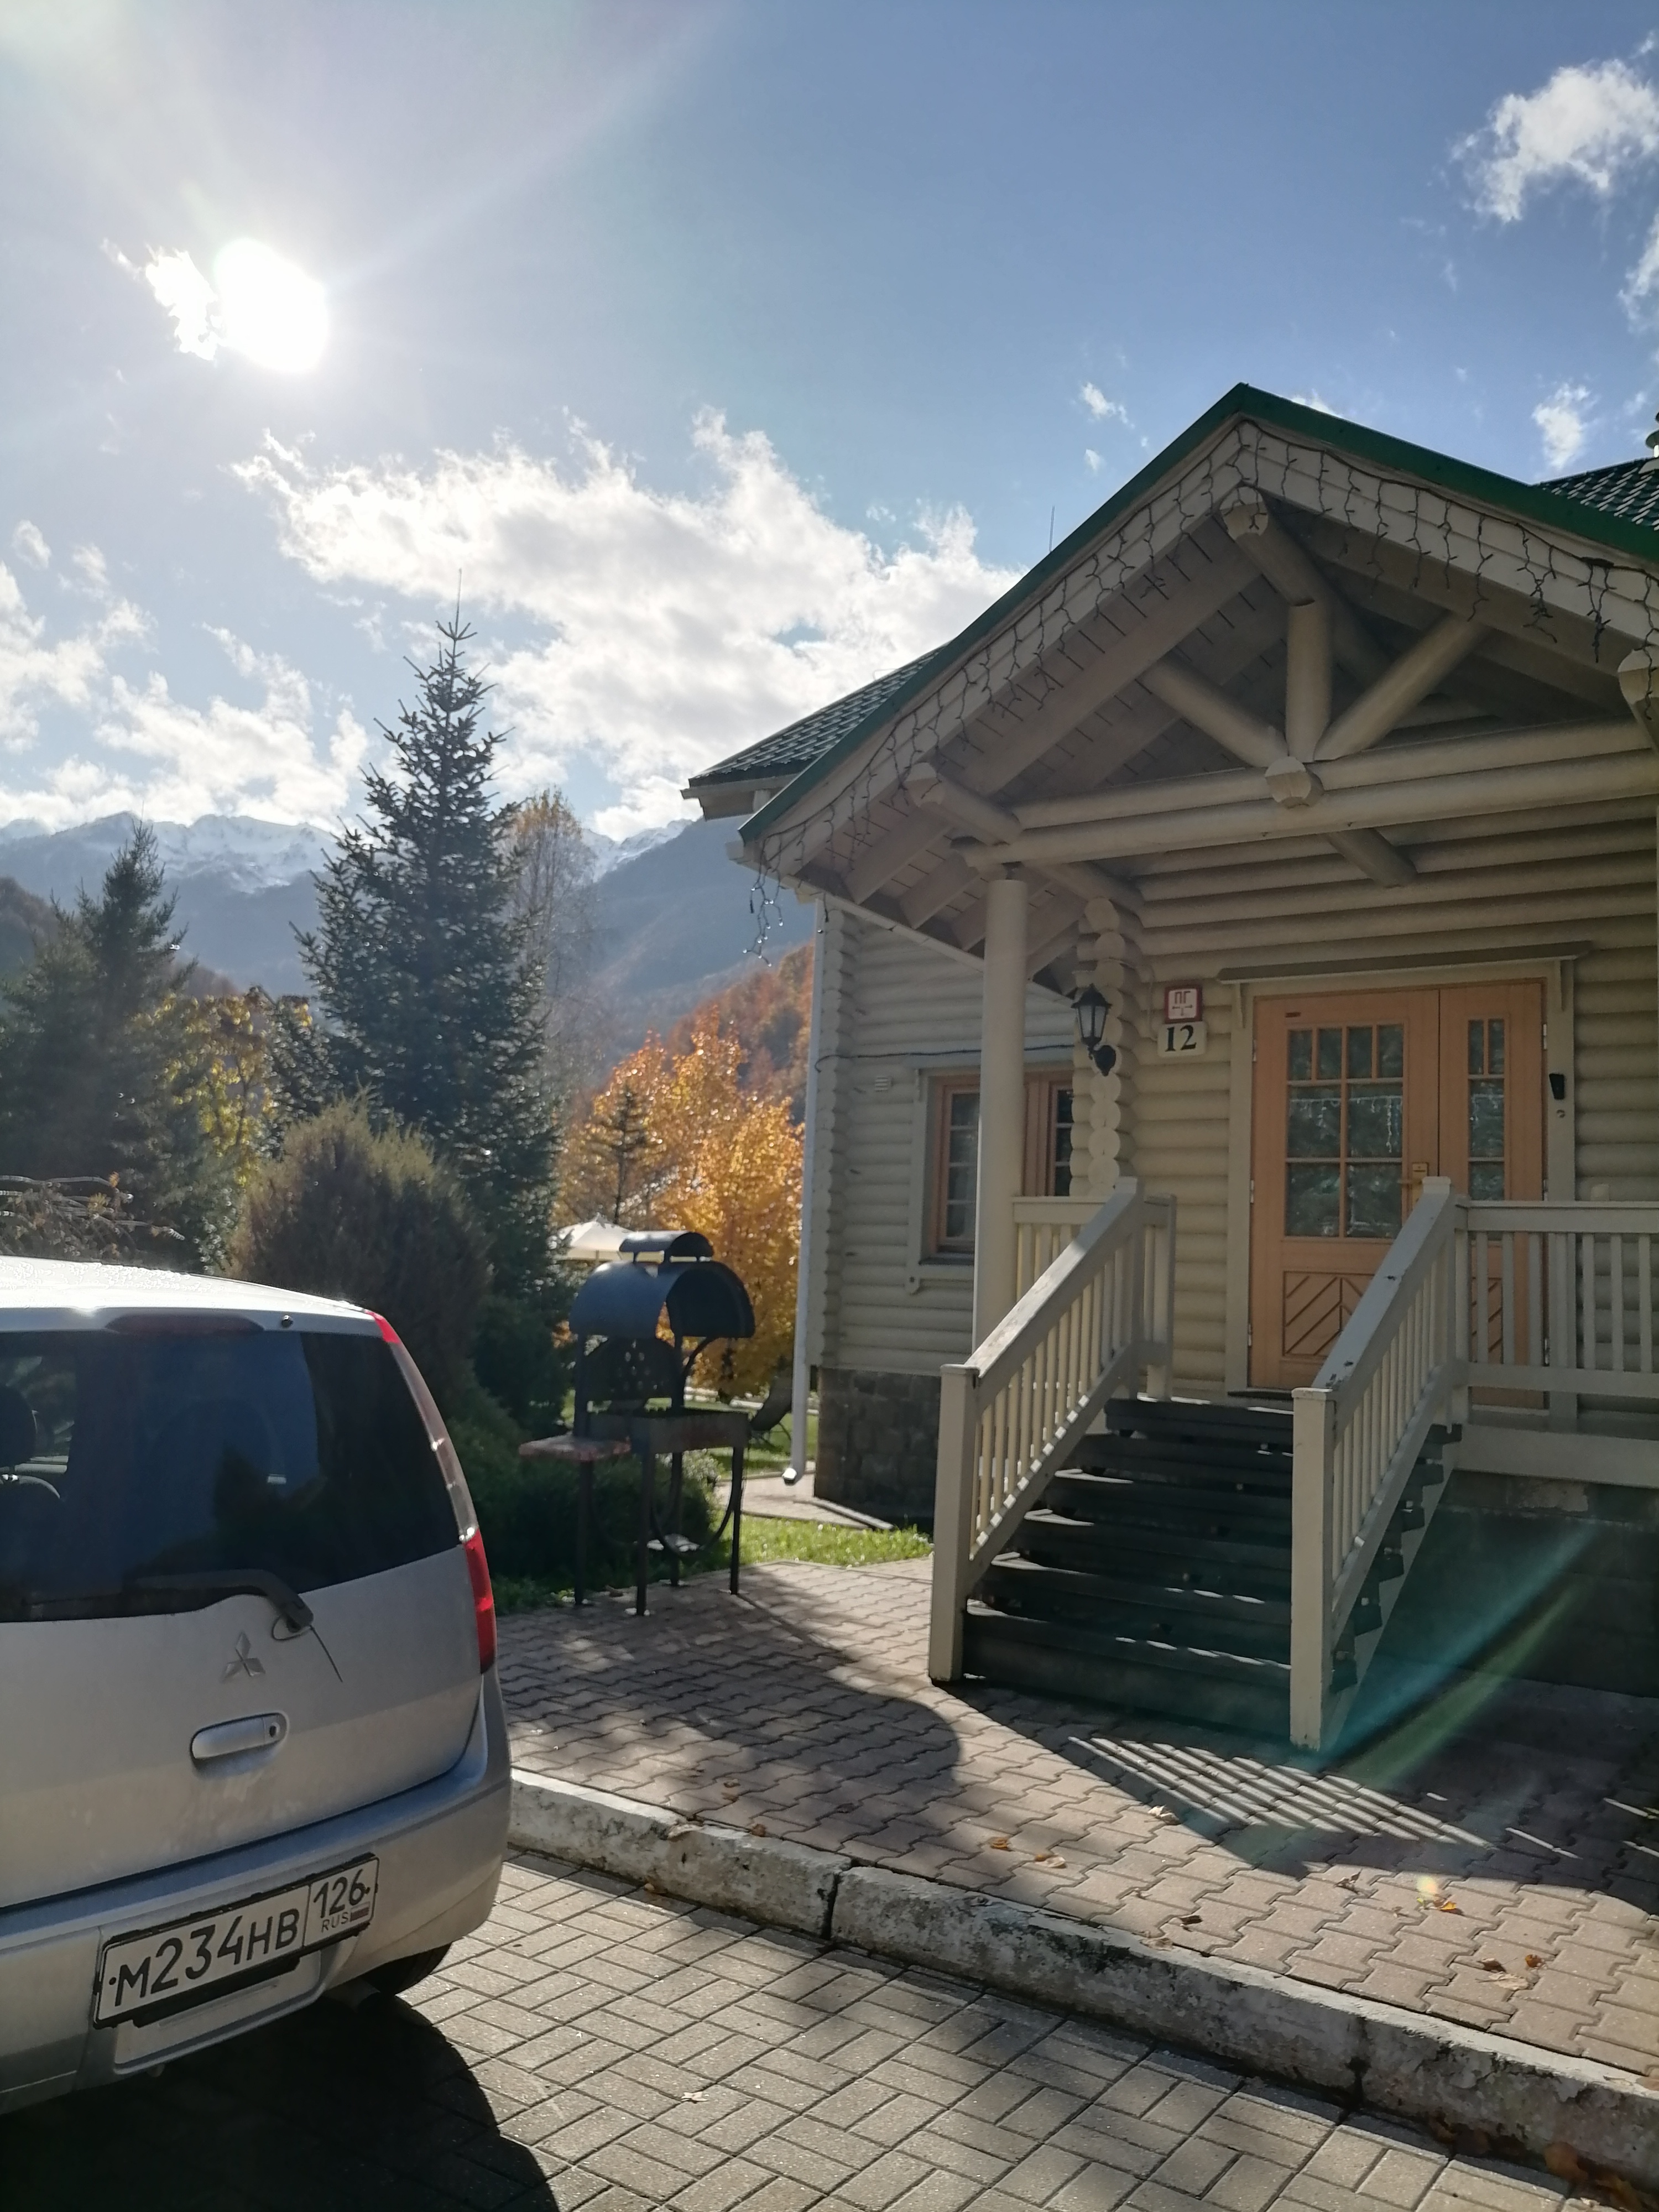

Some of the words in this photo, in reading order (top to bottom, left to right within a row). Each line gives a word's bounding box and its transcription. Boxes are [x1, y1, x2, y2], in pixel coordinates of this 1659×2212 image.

[1175, 990, 1191, 1004] ПГ
[1165, 1025, 1197, 1052] 12
[313, 1869, 365, 1919] 126
[321, 1912, 349, 1933] RUS
